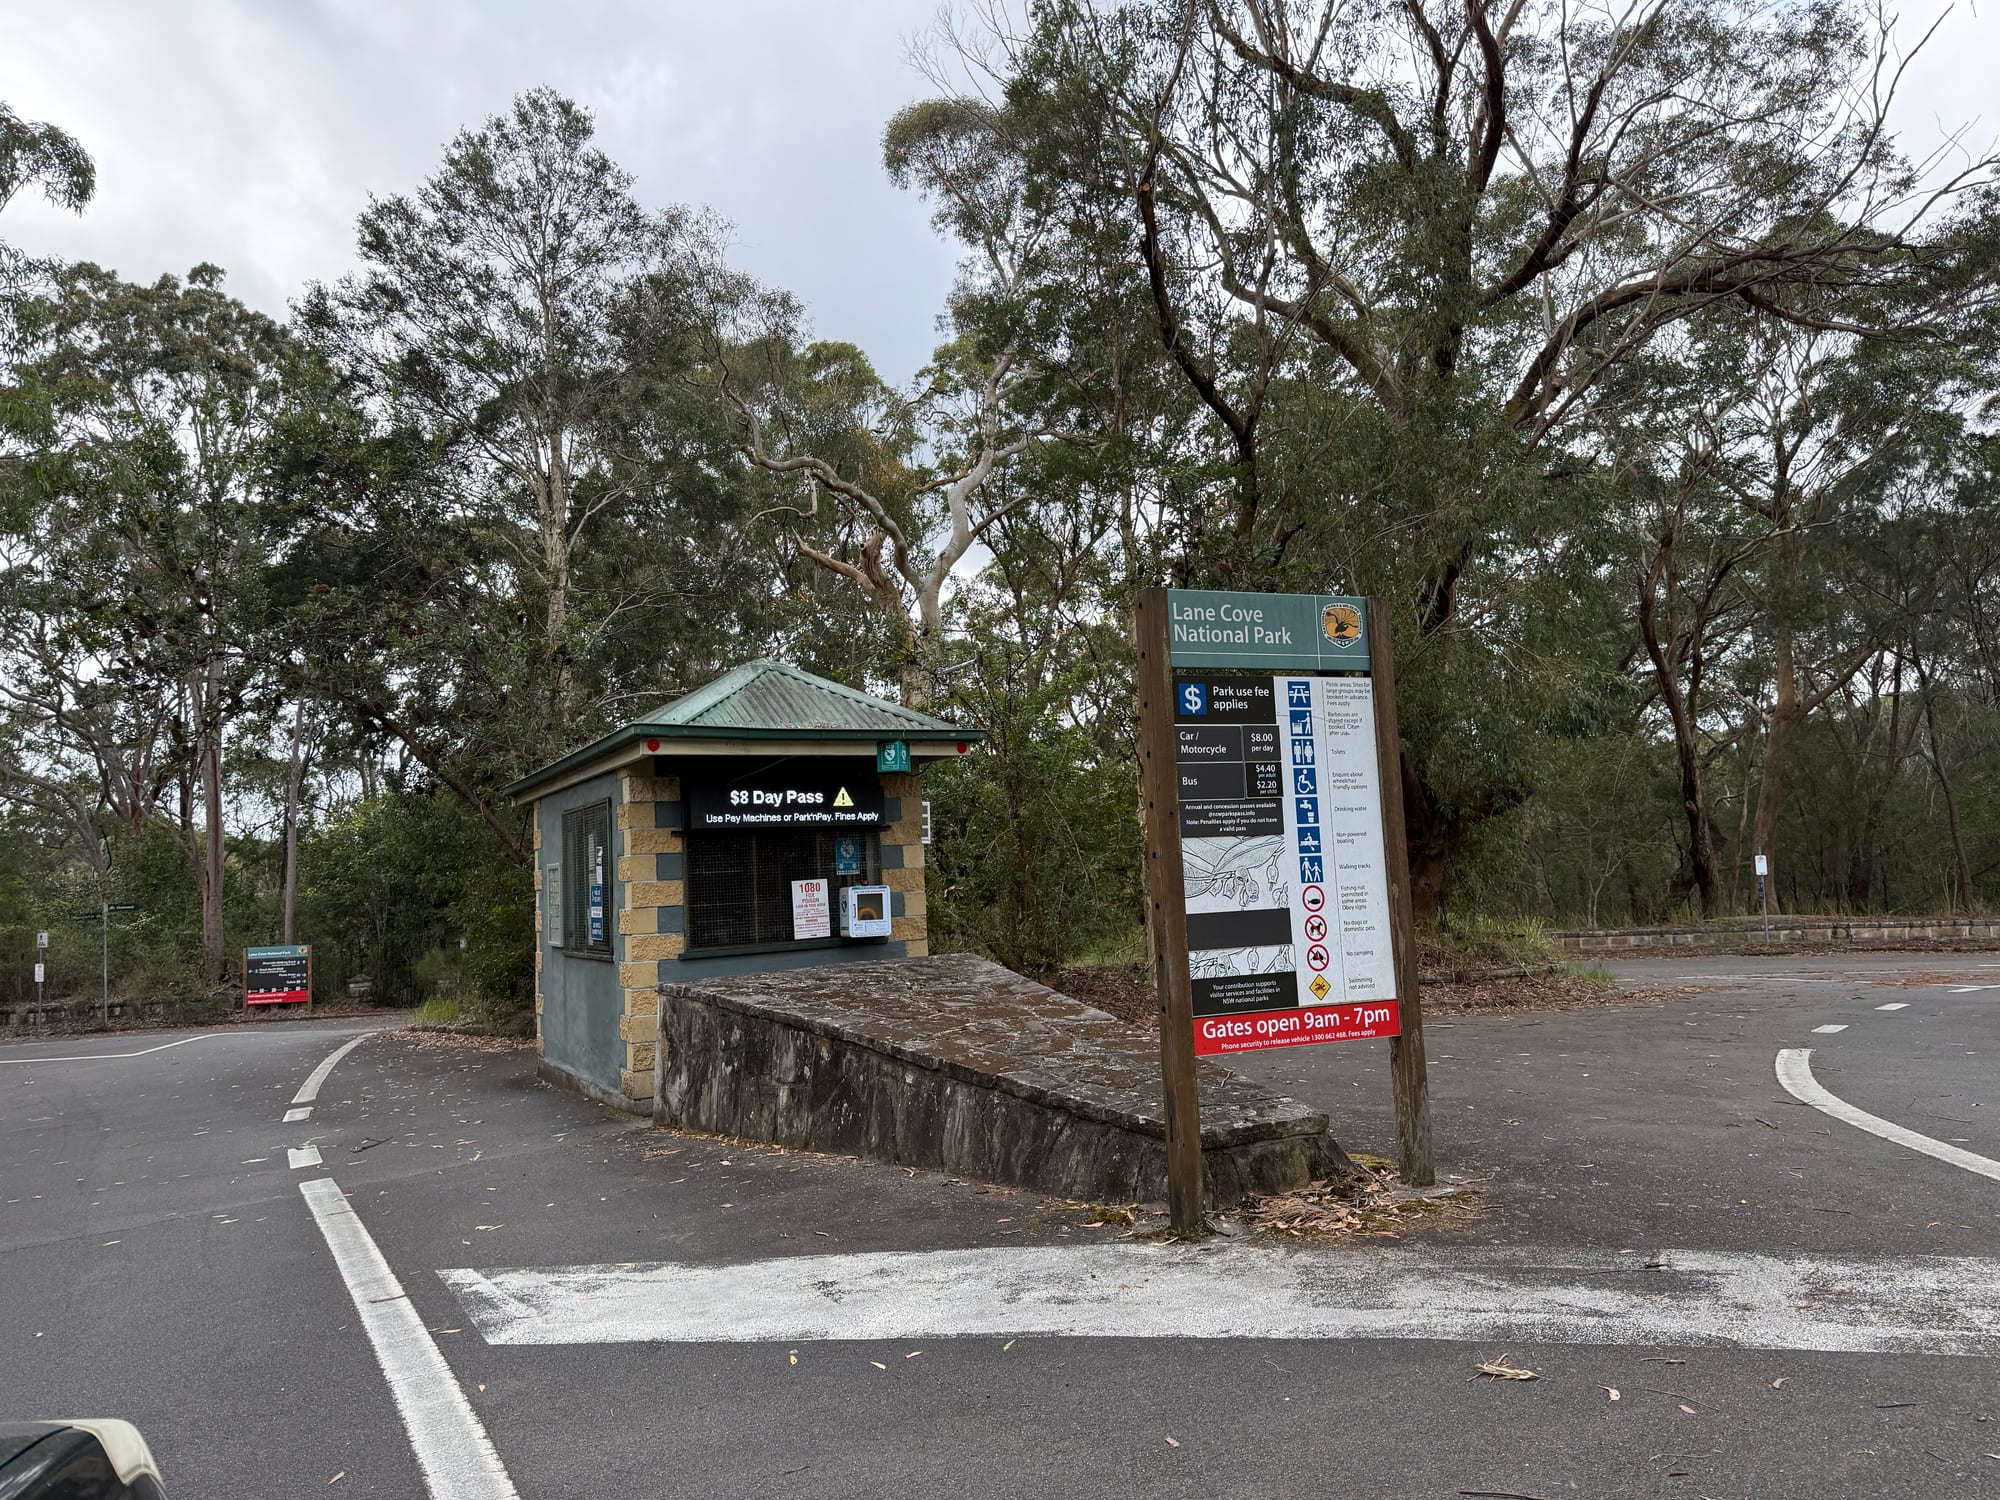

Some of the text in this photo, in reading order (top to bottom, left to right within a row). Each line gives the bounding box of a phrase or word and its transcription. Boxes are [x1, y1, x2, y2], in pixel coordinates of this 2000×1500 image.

[1173, 602, 1263, 622] Lane Cove
[1174, 624, 1292, 645] National Park
[1213, 686, 1270, 697] Park use fee
[1184, 684, 1202, 713] $
[1213, 699, 1248, 711] applies
[1180, 732, 1199, 741] Car /
[1251, 733, 1273, 742] $8.00
[1180, 745, 1227, 755] Motorcycle
[1263, 744, 1273, 752] day
[1256, 764, 1275, 773] $4.40
[1182, 777, 1197, 785] Bus
[1257, 781, 1276, 789] $2.20
[730, 790, 823, 807] $8 Day Pass
[706, 814, 723, 823] Use
[725, 814, 740, 824] Pay
[743, 814, 781, 822] Machines
[835, 812, 856, 821] Fines
[857, 812, 878, 821] Apply
[800, 883, 820, 893] 1080
[1203, 1021, 1252, 1039] Gates
[1257, 1016, 1300, 1037] open
[1304, 1012, 1340, 1029] 9am
[1354, 1007, 1390, 1028] 7pm
[1241, 1040, 1262, 1048] security
[1291, 1035, 1310, 1043] vehicle
